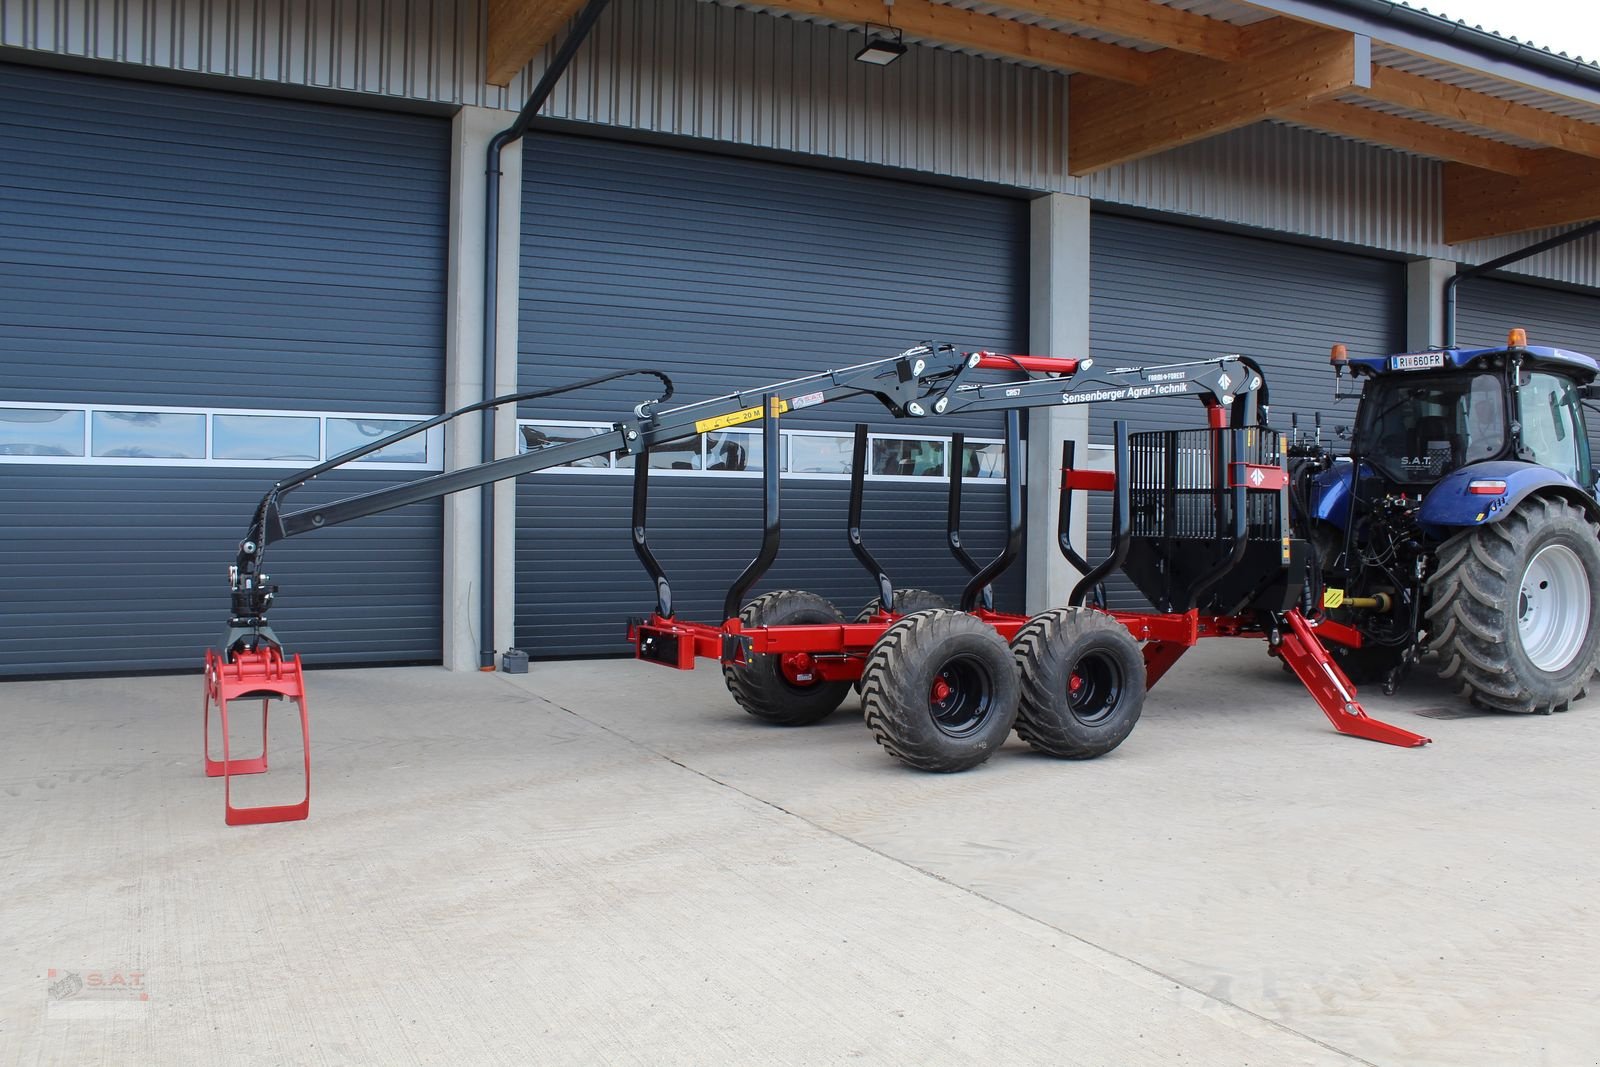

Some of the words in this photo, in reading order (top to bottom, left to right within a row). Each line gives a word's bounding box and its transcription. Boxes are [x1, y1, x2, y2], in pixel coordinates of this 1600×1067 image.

[1400, 357, 1408, 367] RI
[1167, 372, 1186, 380] FOREST
[1062, 390, 1126, 403] Sensenberger
[1127, 383, 1187, 398] Agrar-Technik
[743, 411, 752, 420] 20
[1401, 456, 1432, 465] S.A.T.
